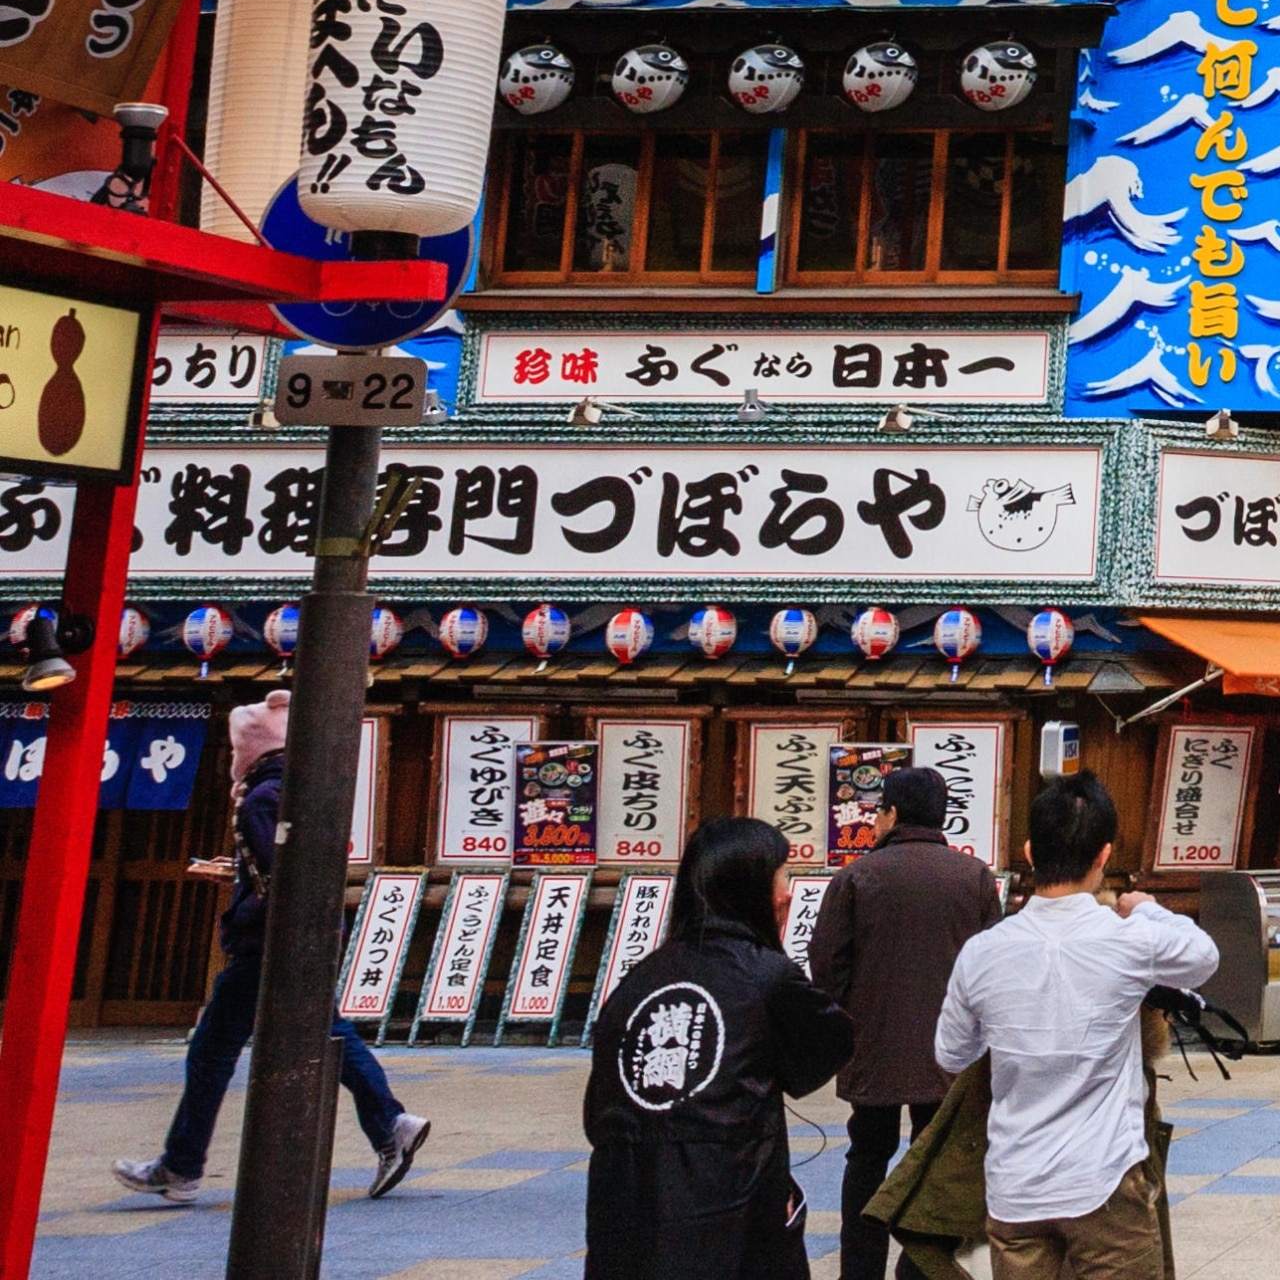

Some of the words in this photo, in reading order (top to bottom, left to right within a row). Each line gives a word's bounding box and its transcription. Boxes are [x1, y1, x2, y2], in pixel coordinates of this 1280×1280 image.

[286, 370, 415, 409] 922
[514, 348, 600, 386] 珍味
[625, 342, 1016, 389] ふぐなら日本一
[0, 462, 947, 560] ふ料理専門づぼらや
[468, 725, 512, 827] ふぐゆびき
[621, 729, 664, 832] ふぐ皮ちり
[774, 733, 819, 835] ふぐ天ぷら
[1172, 736, 1210, 837] にぎり盛合せ
[1208, 738, 1239, 771] ふぐ
[462, 836, 507, 853] 840
[616, 840, 662, 857] 840
[359, 885, 406, 988] ふぐかつ丼
[446, 884, 490, 988] ふぐうどん定食
[530, 885, 572, 989] 天丼定食
[618, 884, 659, 981] 豚ひれかつ定
[644, 1001, 693, 1090] 横綱
